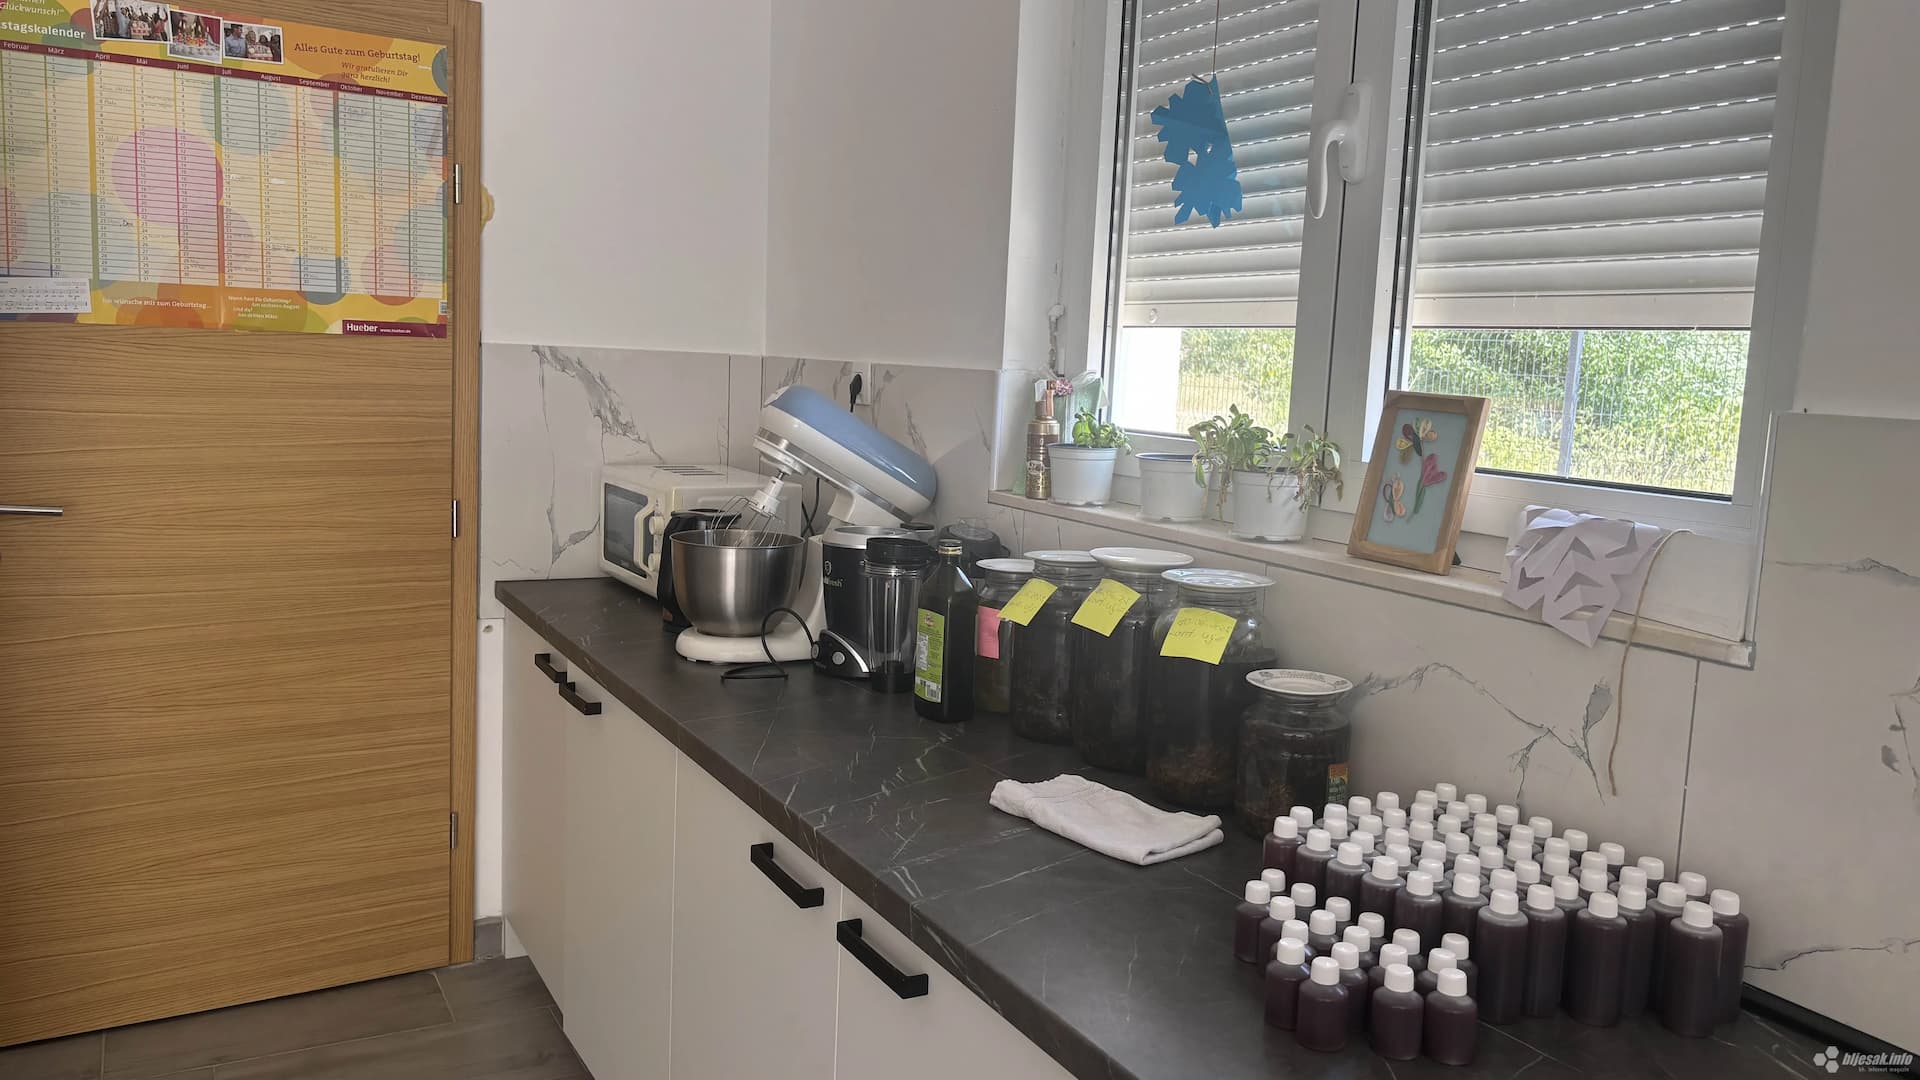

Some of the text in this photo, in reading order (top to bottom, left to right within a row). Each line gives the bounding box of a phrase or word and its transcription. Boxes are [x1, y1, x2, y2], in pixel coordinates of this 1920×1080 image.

[3, 41, 29, 50] Februar
[48, 47, 65, 55] März
[294, 43, 421, 63] Alles Gute zum Geburtstag!
[95, 53, 111, 61] April
[260, 74, 281, 83] August
[298, 78, 330, 89] September
[340, 84, 363, 93] Oktober
[375, 88, 404, 98] November
[410, 93, 438, 103] Dezember
[346, 323, 378, 333] Hueber
